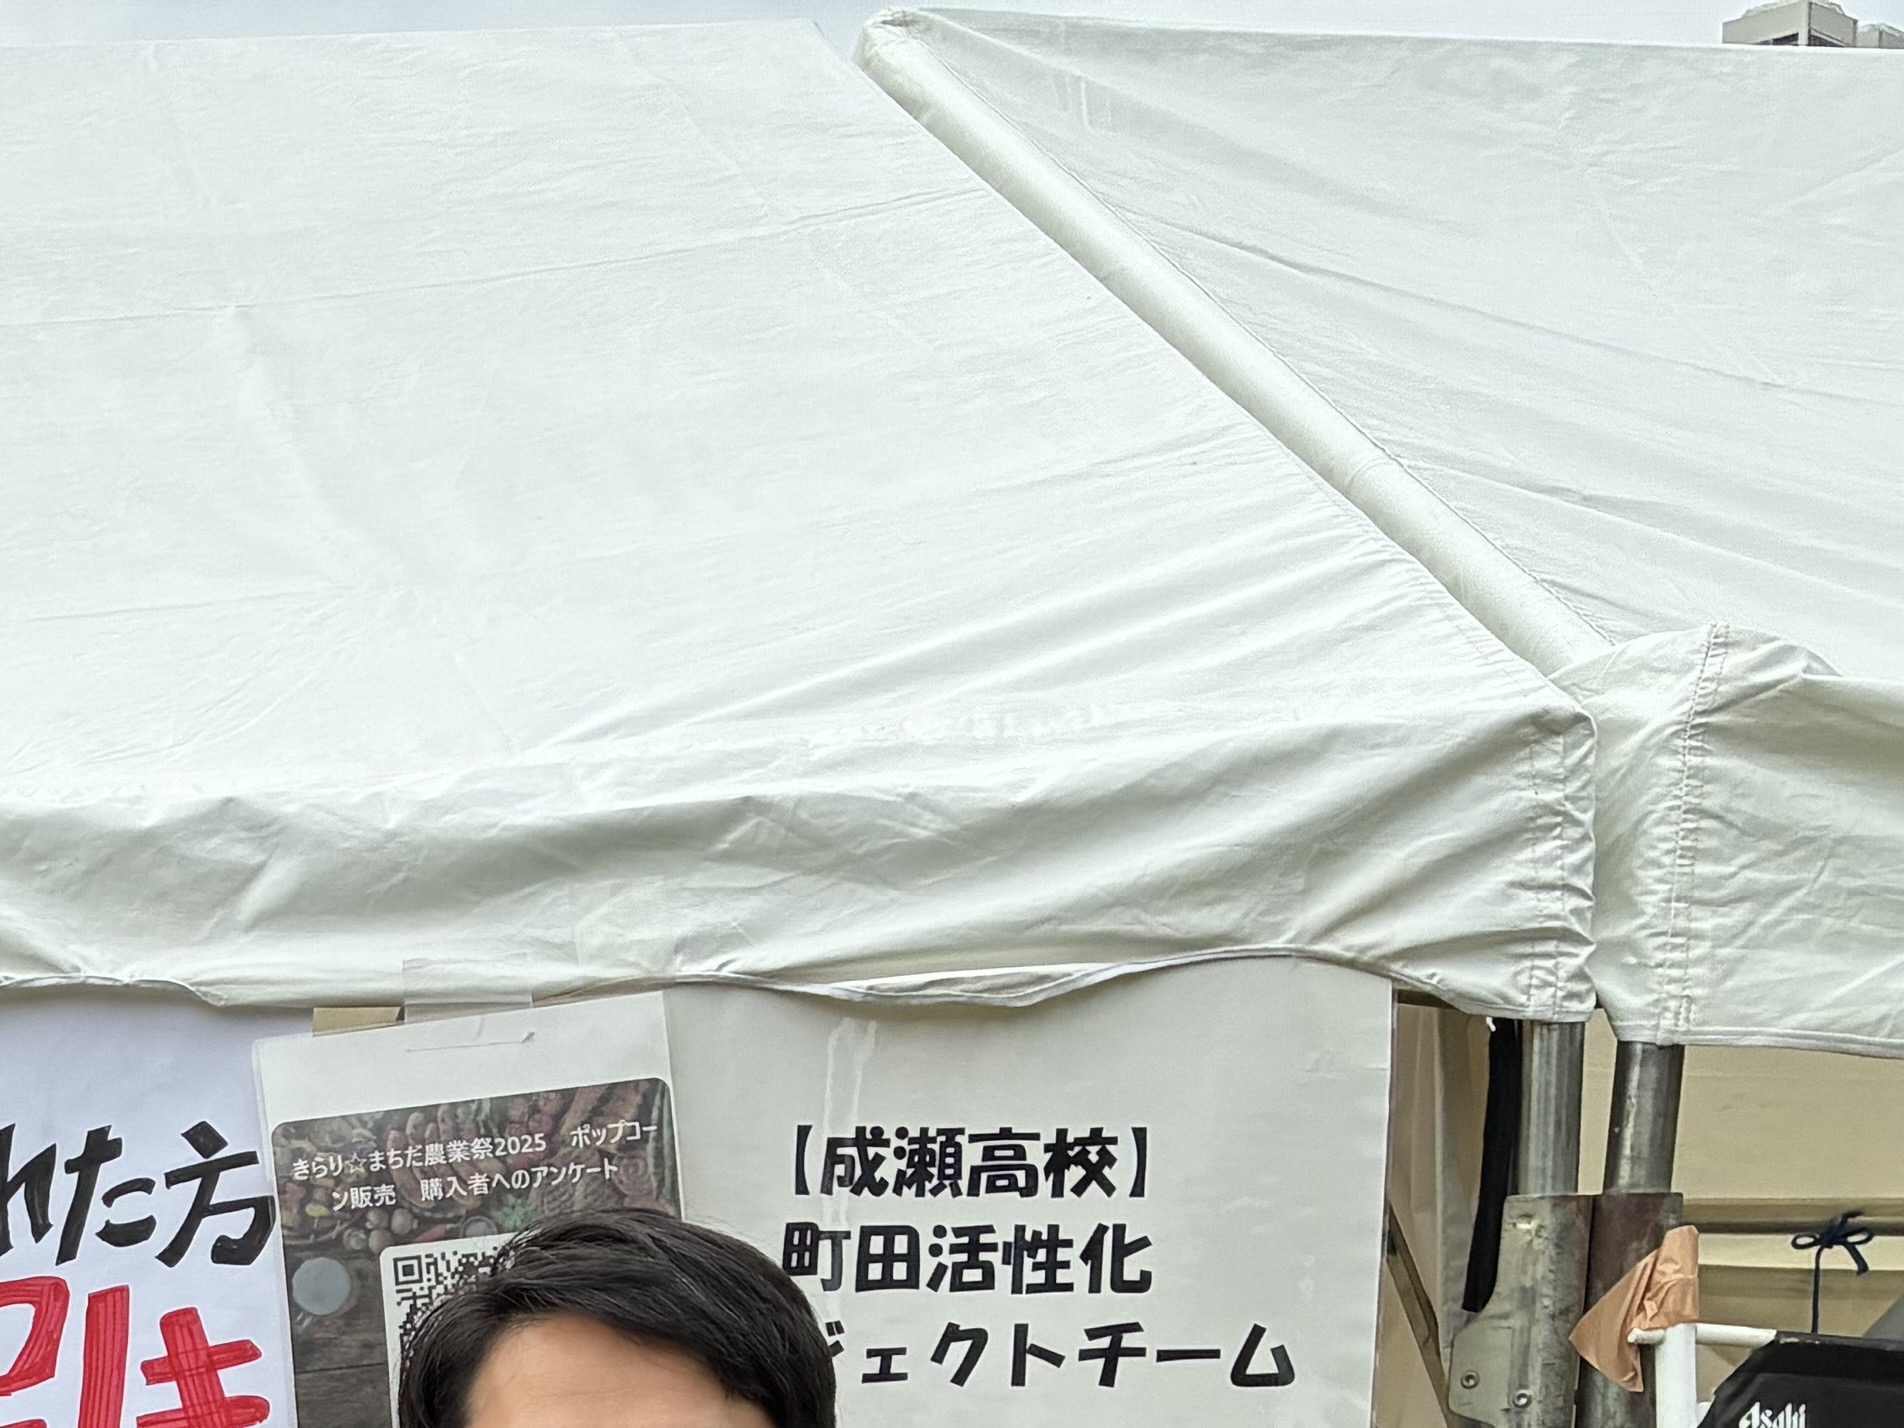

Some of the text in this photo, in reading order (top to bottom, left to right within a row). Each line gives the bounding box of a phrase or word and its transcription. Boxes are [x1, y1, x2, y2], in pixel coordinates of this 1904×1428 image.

[570, 1120, 659, 1149] ポップコー
[794, 1125, 1149, 1199] 【成瀬高校】
[331, 1157, 619, 1212] ン販売 購入者へのアンケート
[783, 1221, 1153, 1295] 町田活性化
